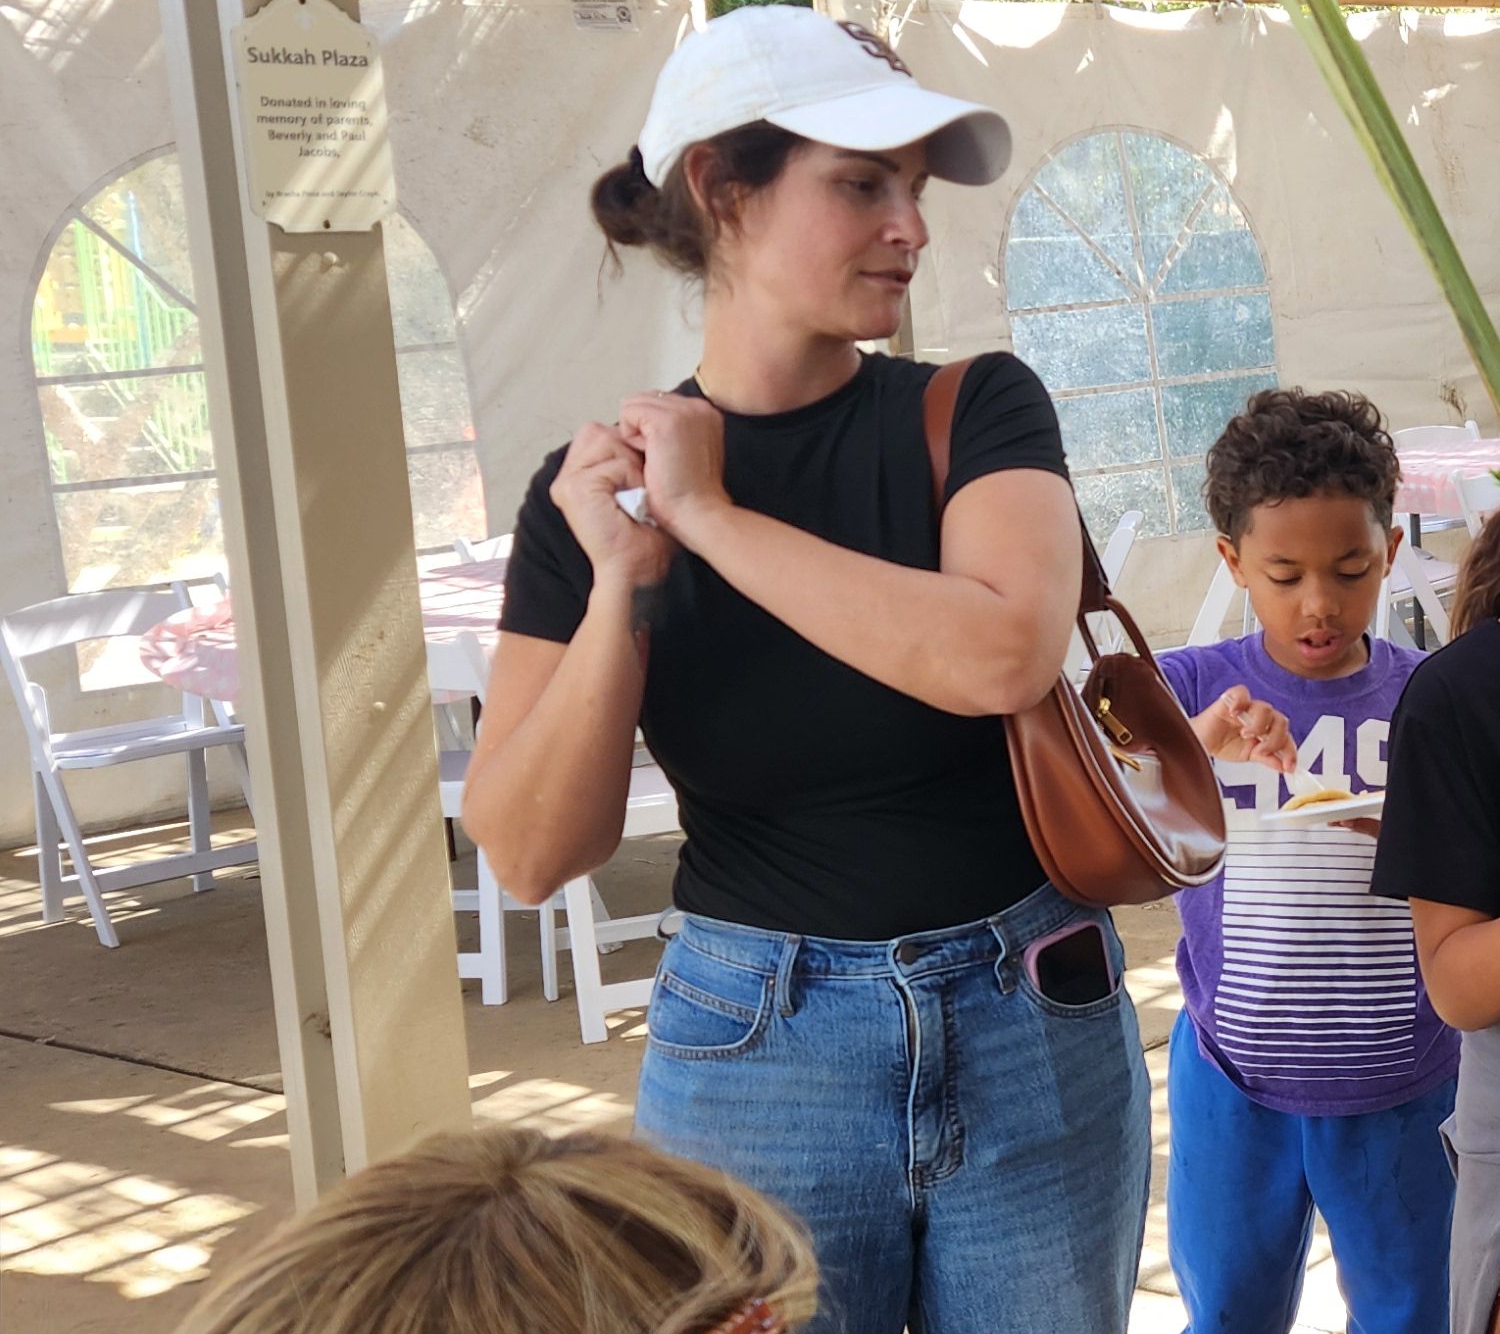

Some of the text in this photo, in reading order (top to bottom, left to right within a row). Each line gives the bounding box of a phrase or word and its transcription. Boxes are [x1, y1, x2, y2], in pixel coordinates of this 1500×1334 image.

[247, 46, 369, 67] Sukkah Plaza
[260, 96, 366, 111] Donated in loving
[256, 115, 307, 127] memory
[310, 113, 322, 124] of
[267, 129, 366, 144] Beverly and Paul
